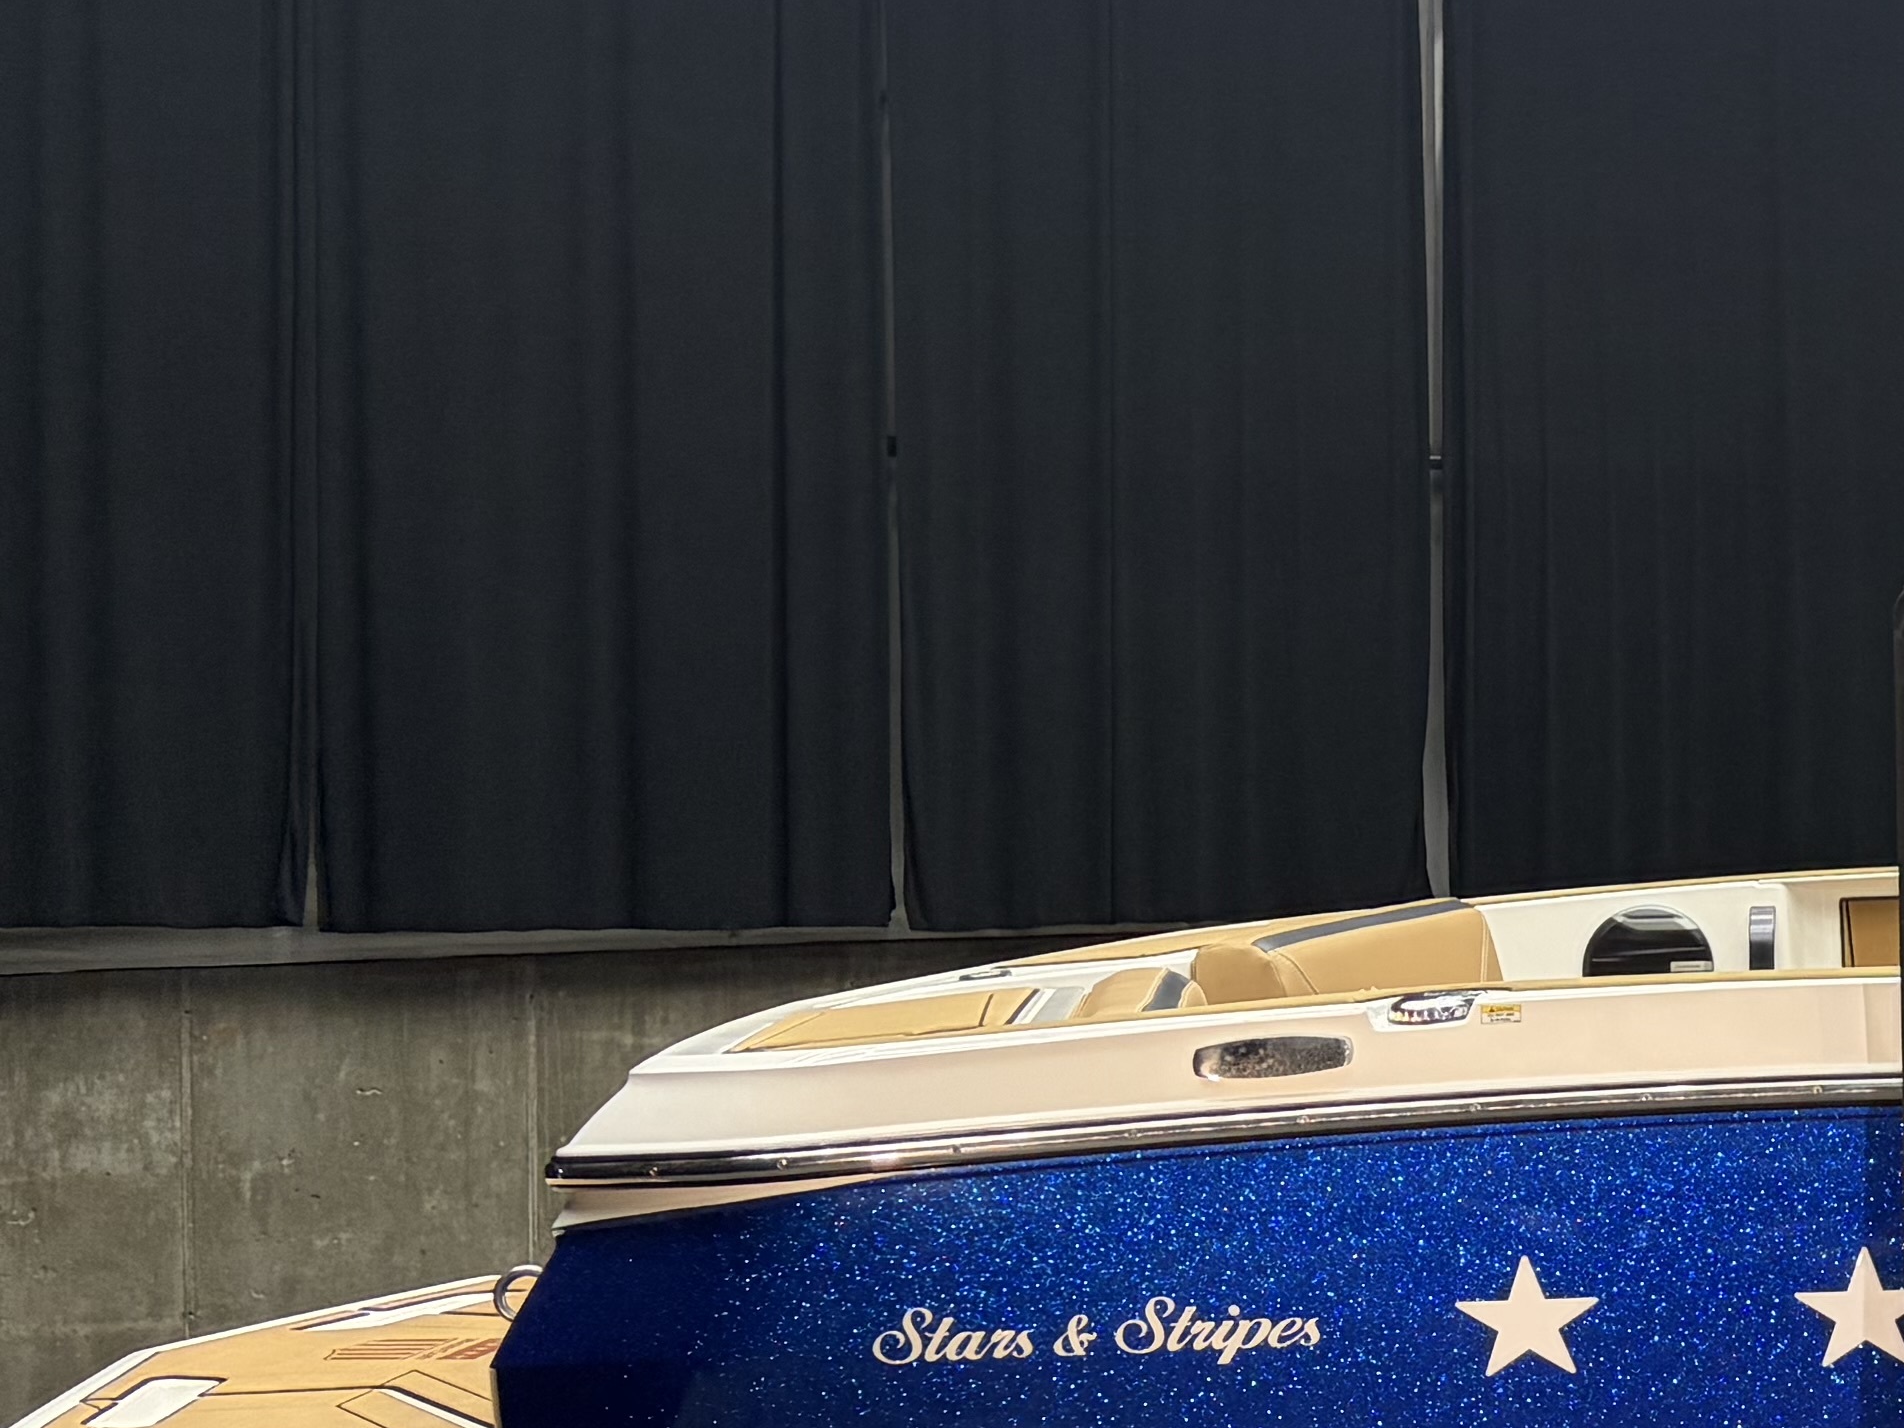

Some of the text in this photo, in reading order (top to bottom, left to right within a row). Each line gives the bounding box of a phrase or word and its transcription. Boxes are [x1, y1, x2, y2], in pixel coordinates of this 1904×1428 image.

[872, 1295, 1320, 1366] Stars & Stripes
